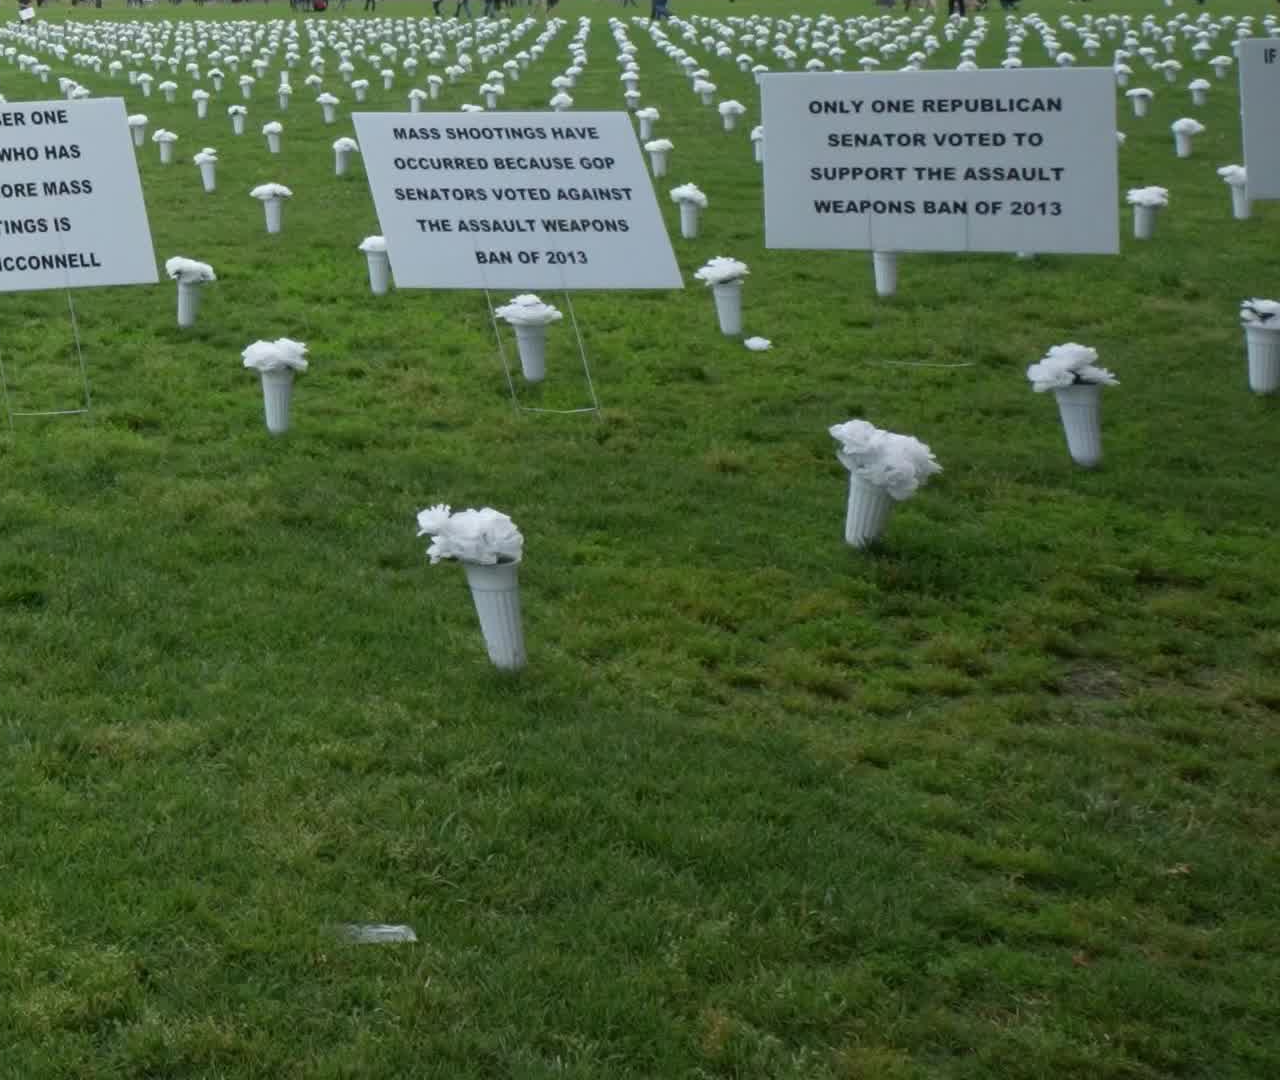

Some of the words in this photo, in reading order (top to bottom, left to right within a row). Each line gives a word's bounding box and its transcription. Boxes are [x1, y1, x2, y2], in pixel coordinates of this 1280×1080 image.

[1263, 47, 1278, 65] IF
[808, 100, 865, 115] ONLY
[871, 99, 916, 114] ONE
[921, 97, 1063, 113] REPUBLICAN
[30, 109, 69, 126] ONE
[392, 126, 442, 141] MASS
[445, 126, 548, 141] SHOOTINGS
[551, 126, 601, 141] HAVE
[827, 132, 927, 148] SENATOR
[932, 132, 1007, 147] VOTED
[1012, 132, 1044, 148] TO
[44, 143, 82, 160] HAS
[393, 156, 489, 171] OCCURRED
[494, 156, 575, 171] BECAUSE
[579, 156, 616, 171] GOP
[810, 166, 908, 181] SUPPORT
[913, 166, 957, 182] THE
[963, 167, 1065, 182] ASSAULT
[42, 179, 94, 196] MASS
[393, 187, 488, 202] SENATORS
[491, 187, 552, 202] VOTED
[556, 187, 633, 202] AGAINST
[813, 199, 916, 215] WEAPONS
[922, 200, 968, 215] BAN
[974, 200, 1003, 216] OF
[1010, 201, 1062, 217] 2013
[53, 216, 72, 233] IS
[415, 218, 453, 233] THE
[457, 218, 537, 233] ASSAULT
[541, 218, 630, 233] WEAPONS
[474, 250, 513, 265] BAN
[517, 250, 541, 265] OF
[545, 250, 588, 265] 2013
